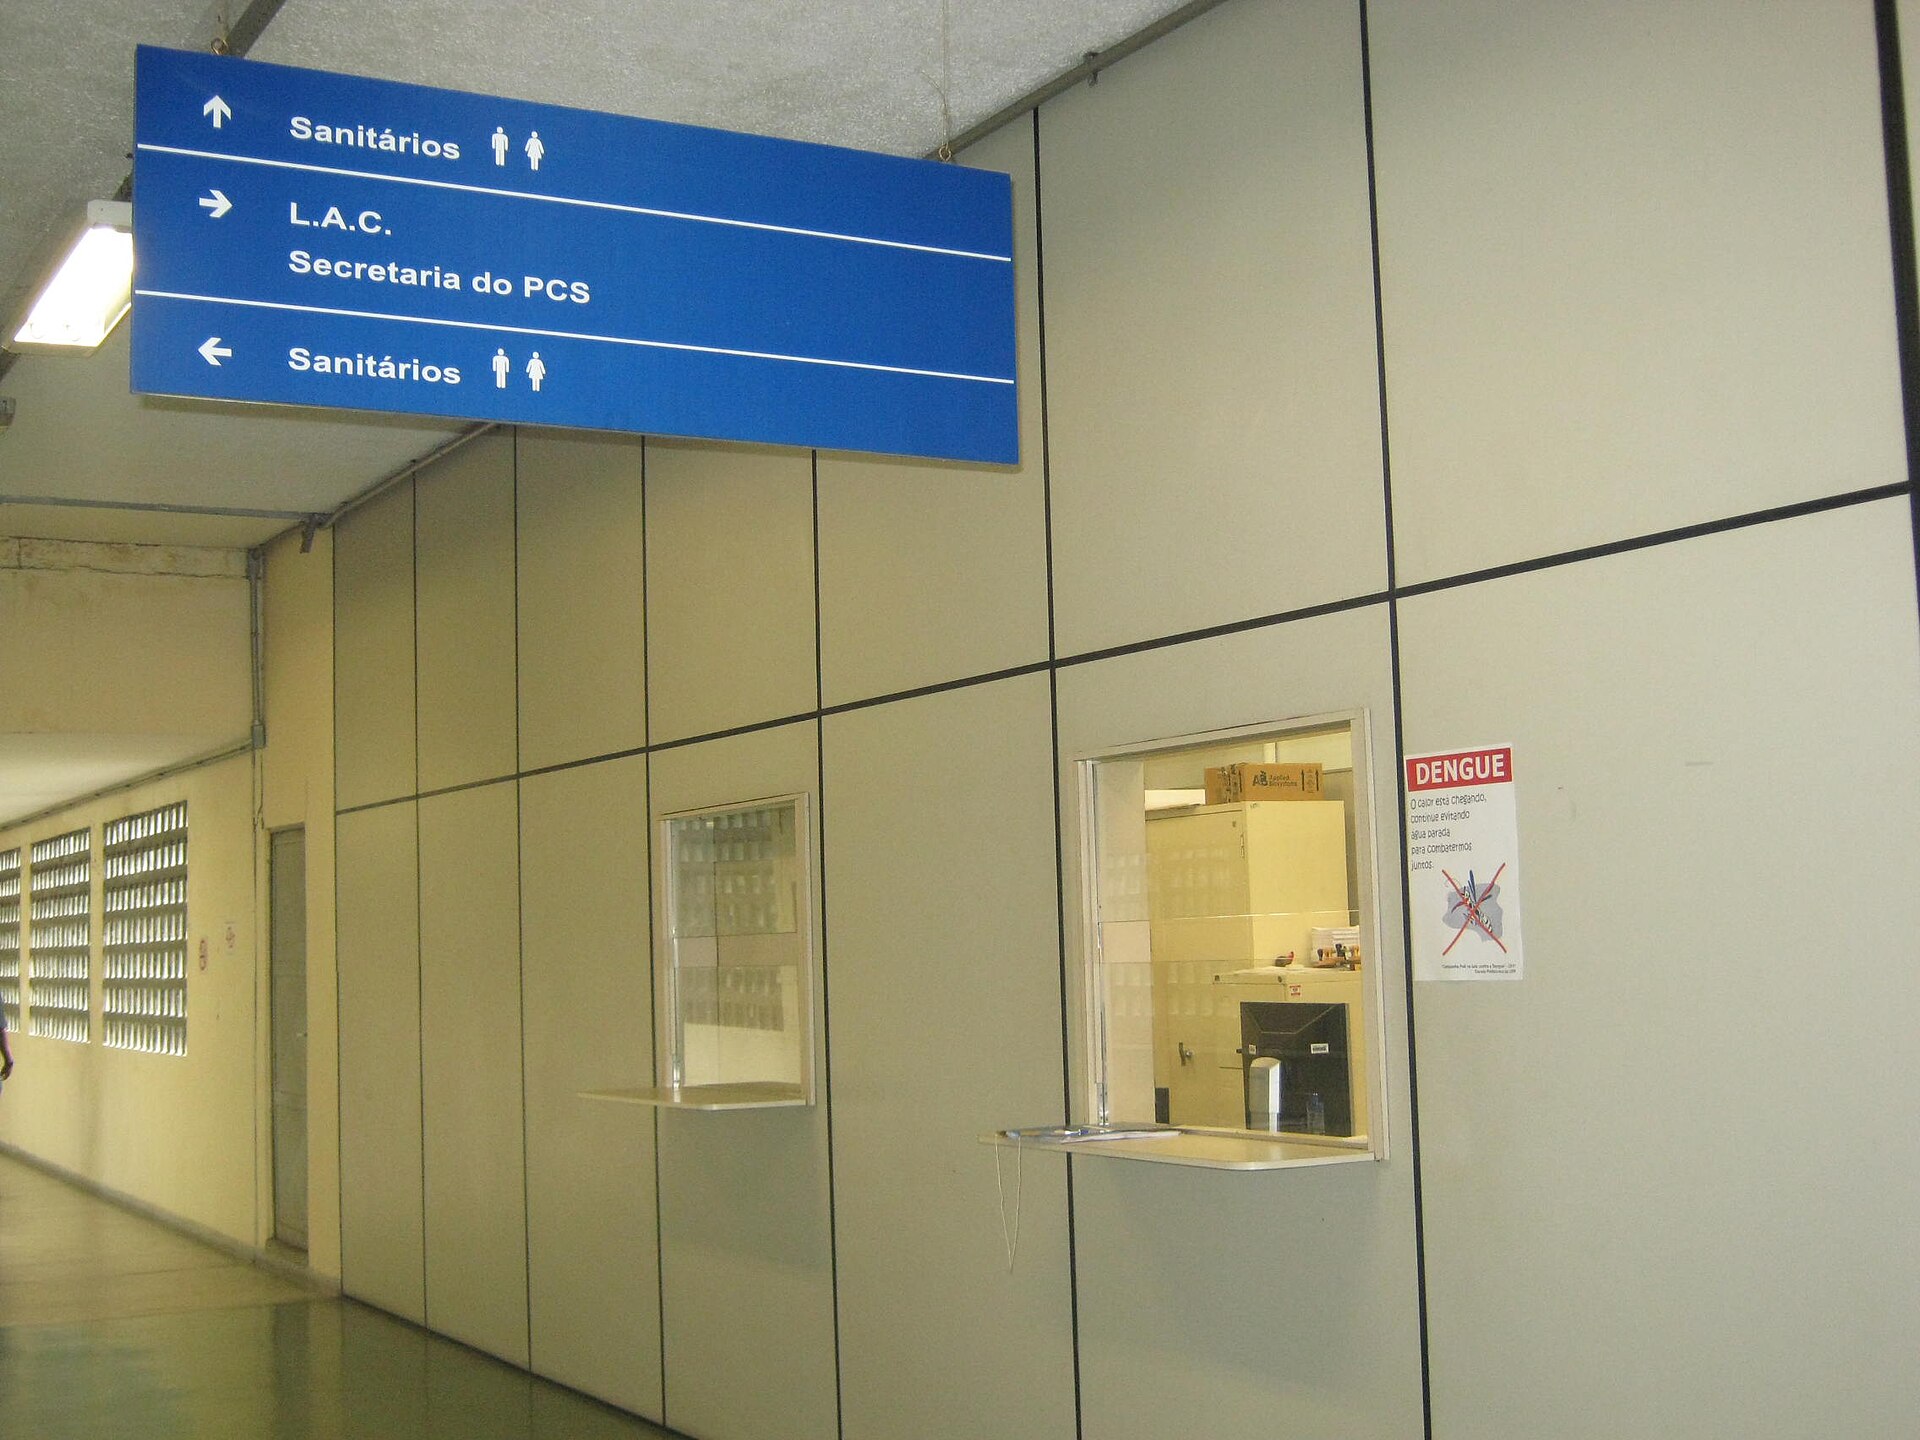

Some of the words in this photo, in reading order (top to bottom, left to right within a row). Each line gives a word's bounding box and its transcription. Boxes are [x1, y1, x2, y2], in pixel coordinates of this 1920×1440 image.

[290, 117, 460, 160] Sanitários
[290, 202, 391, 235] L.A.C.
[289, 251, 461, 290] Secretaria
[472, 272, 512, 294] do
[524, 276, 590, 303] PCS
[289, 348, 461, 384] Sanitários
[1416, 754, 1504, 785] DENGUE
[1411, 799, 1416, 810] O
[1418, 798, 1434, 808] calor
[1411, 813, 1439, 824] continue
[1440, 810, 1470, 821] evitando
[1411, 845, 1426, 855] para
[1427, 842, 1472, 854] combatermos
[1428, 827, 1450, 839] parada
